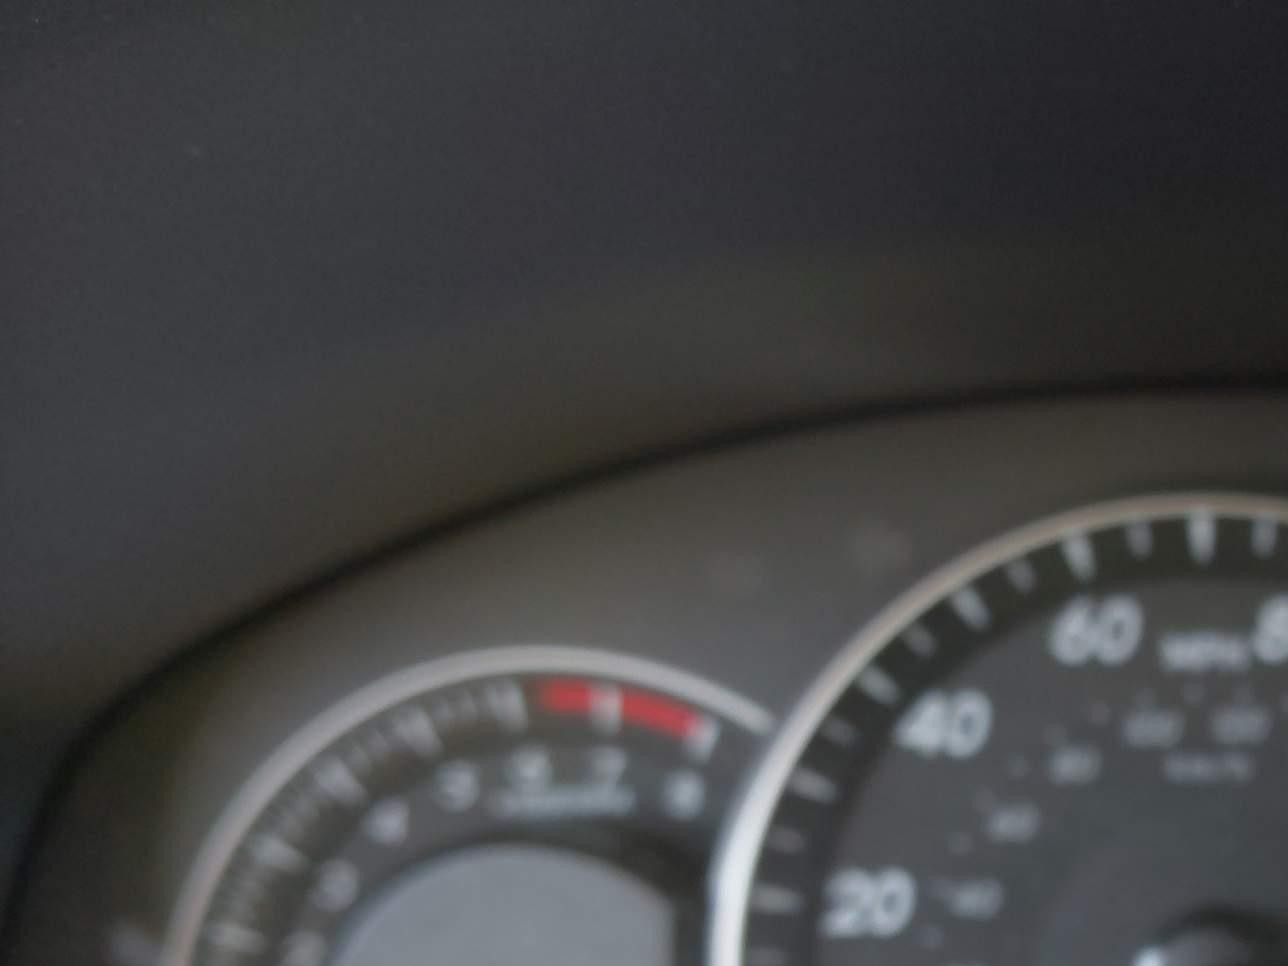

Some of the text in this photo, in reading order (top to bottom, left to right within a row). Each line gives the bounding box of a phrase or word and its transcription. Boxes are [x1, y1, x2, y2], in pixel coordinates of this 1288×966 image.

[1050, 597, 1143, 665] 60
[895, 689, 992, 758] 40
[821, 868, 915, 938] 20
